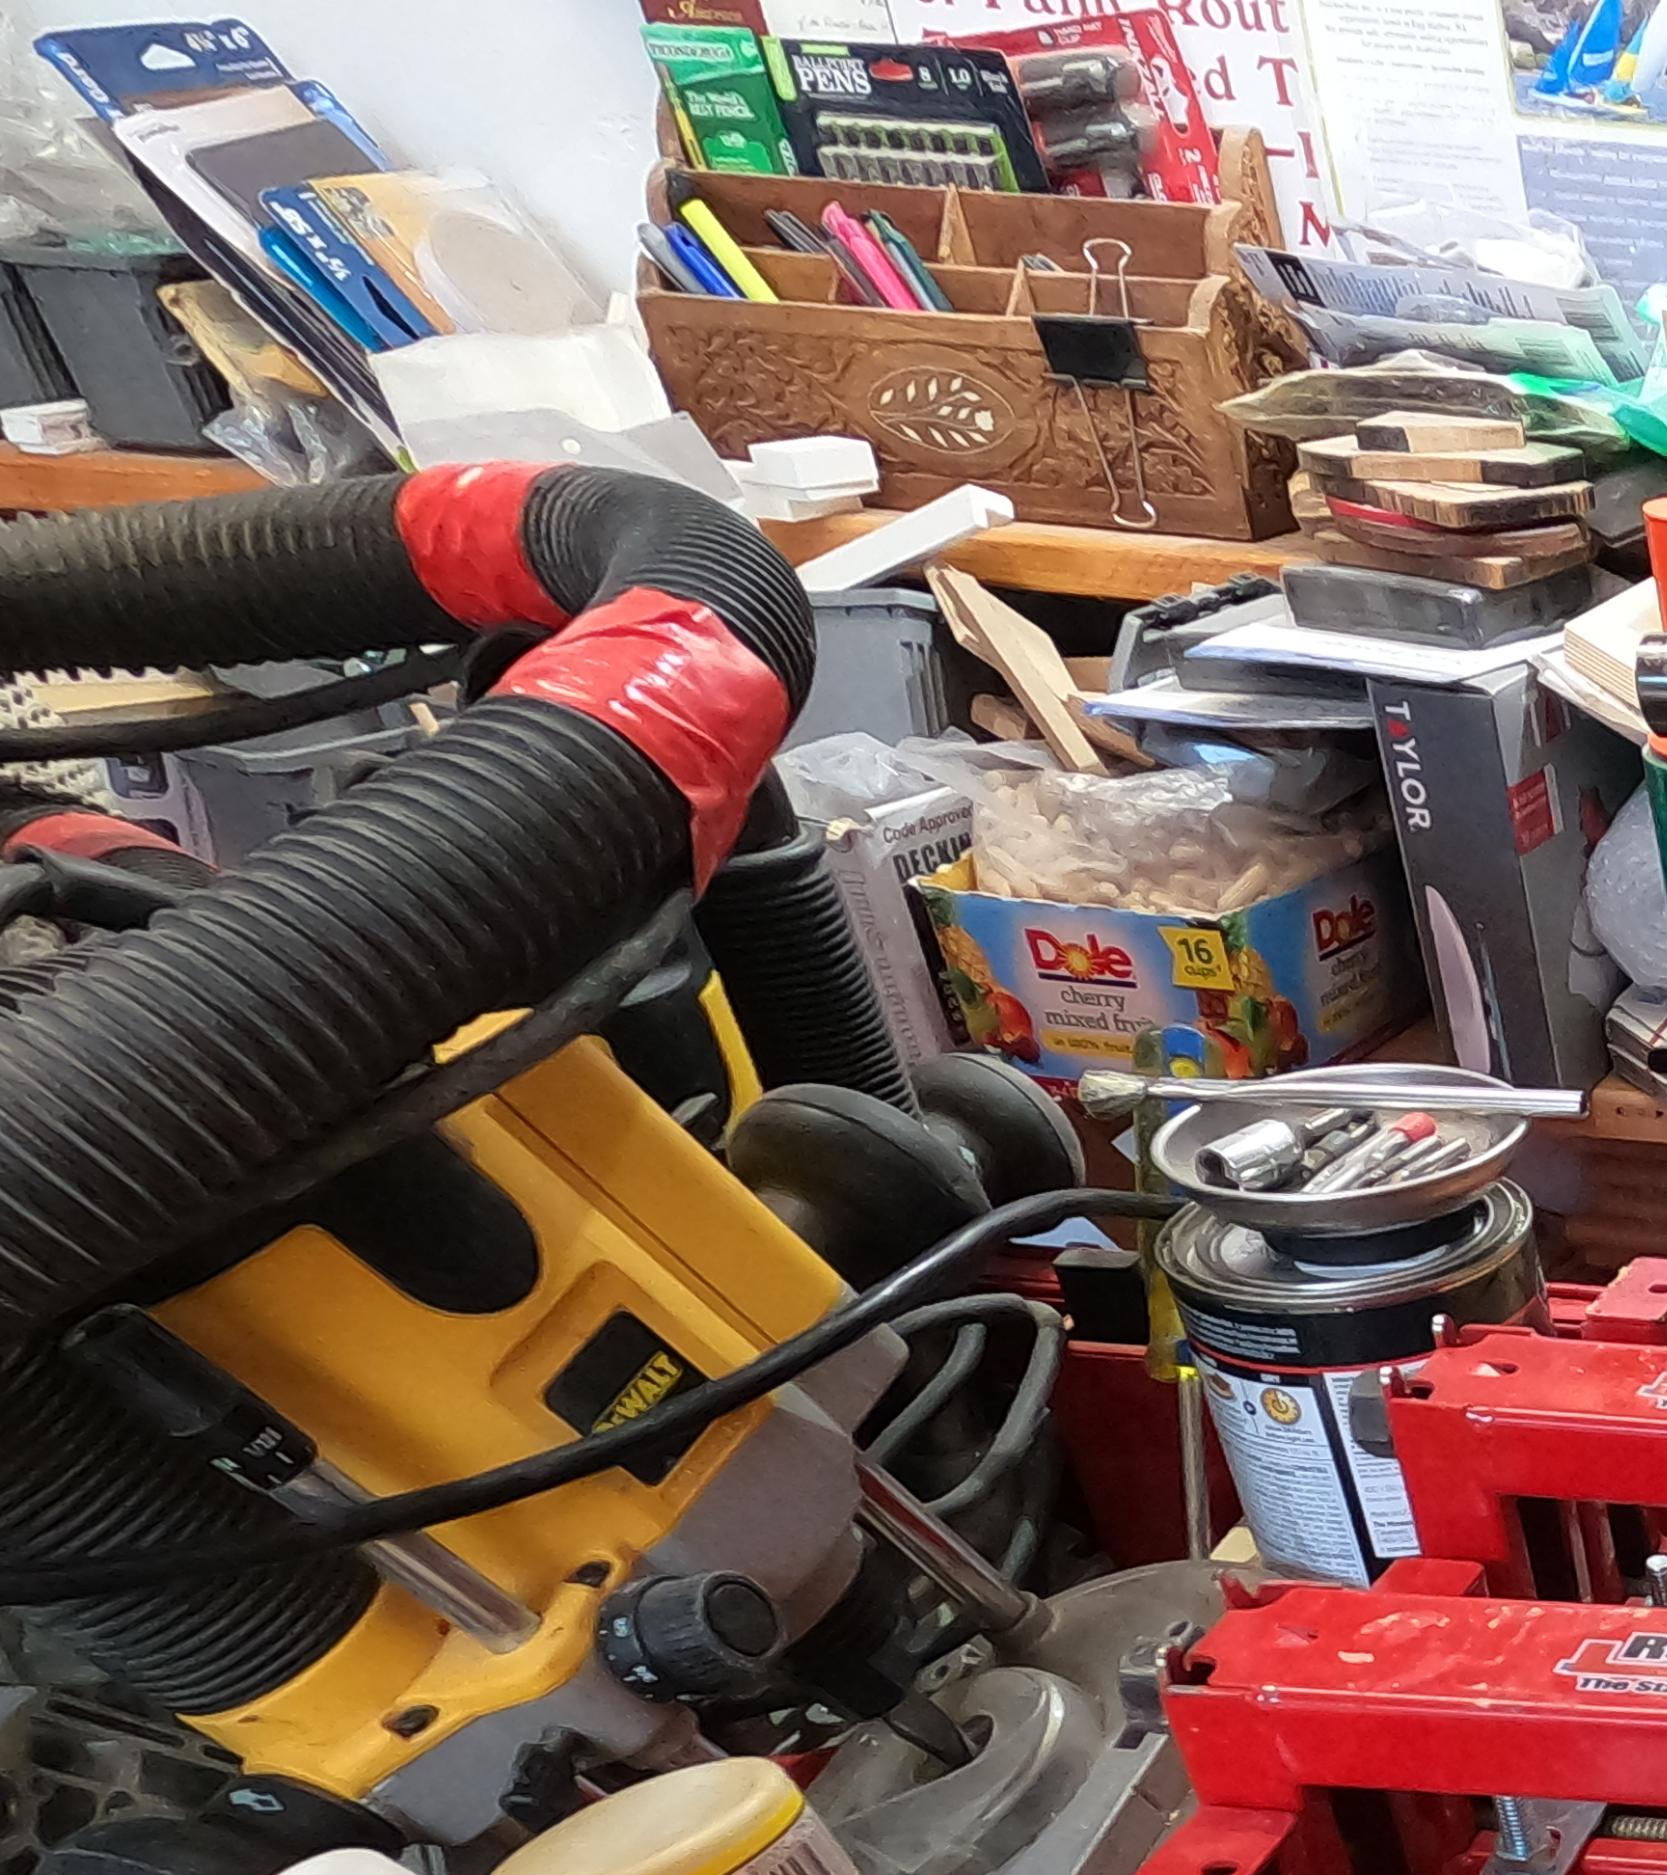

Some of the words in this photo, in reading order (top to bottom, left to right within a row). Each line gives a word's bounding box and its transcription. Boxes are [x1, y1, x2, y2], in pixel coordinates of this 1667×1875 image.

[800, 69, 871, 94] PENS
[1384, 700, 1434, 834] TAYLOR
[1312, 894, 1378, 953] Dole
[1024, 928, 1138, 982] Dole
[1179, 937, 1213, 966] 16
[1059, 985, 1128, 1013] cherry
[1044, 1009, 1110, 1033] mixed
[1577, 1677, 1628, 1692] The
